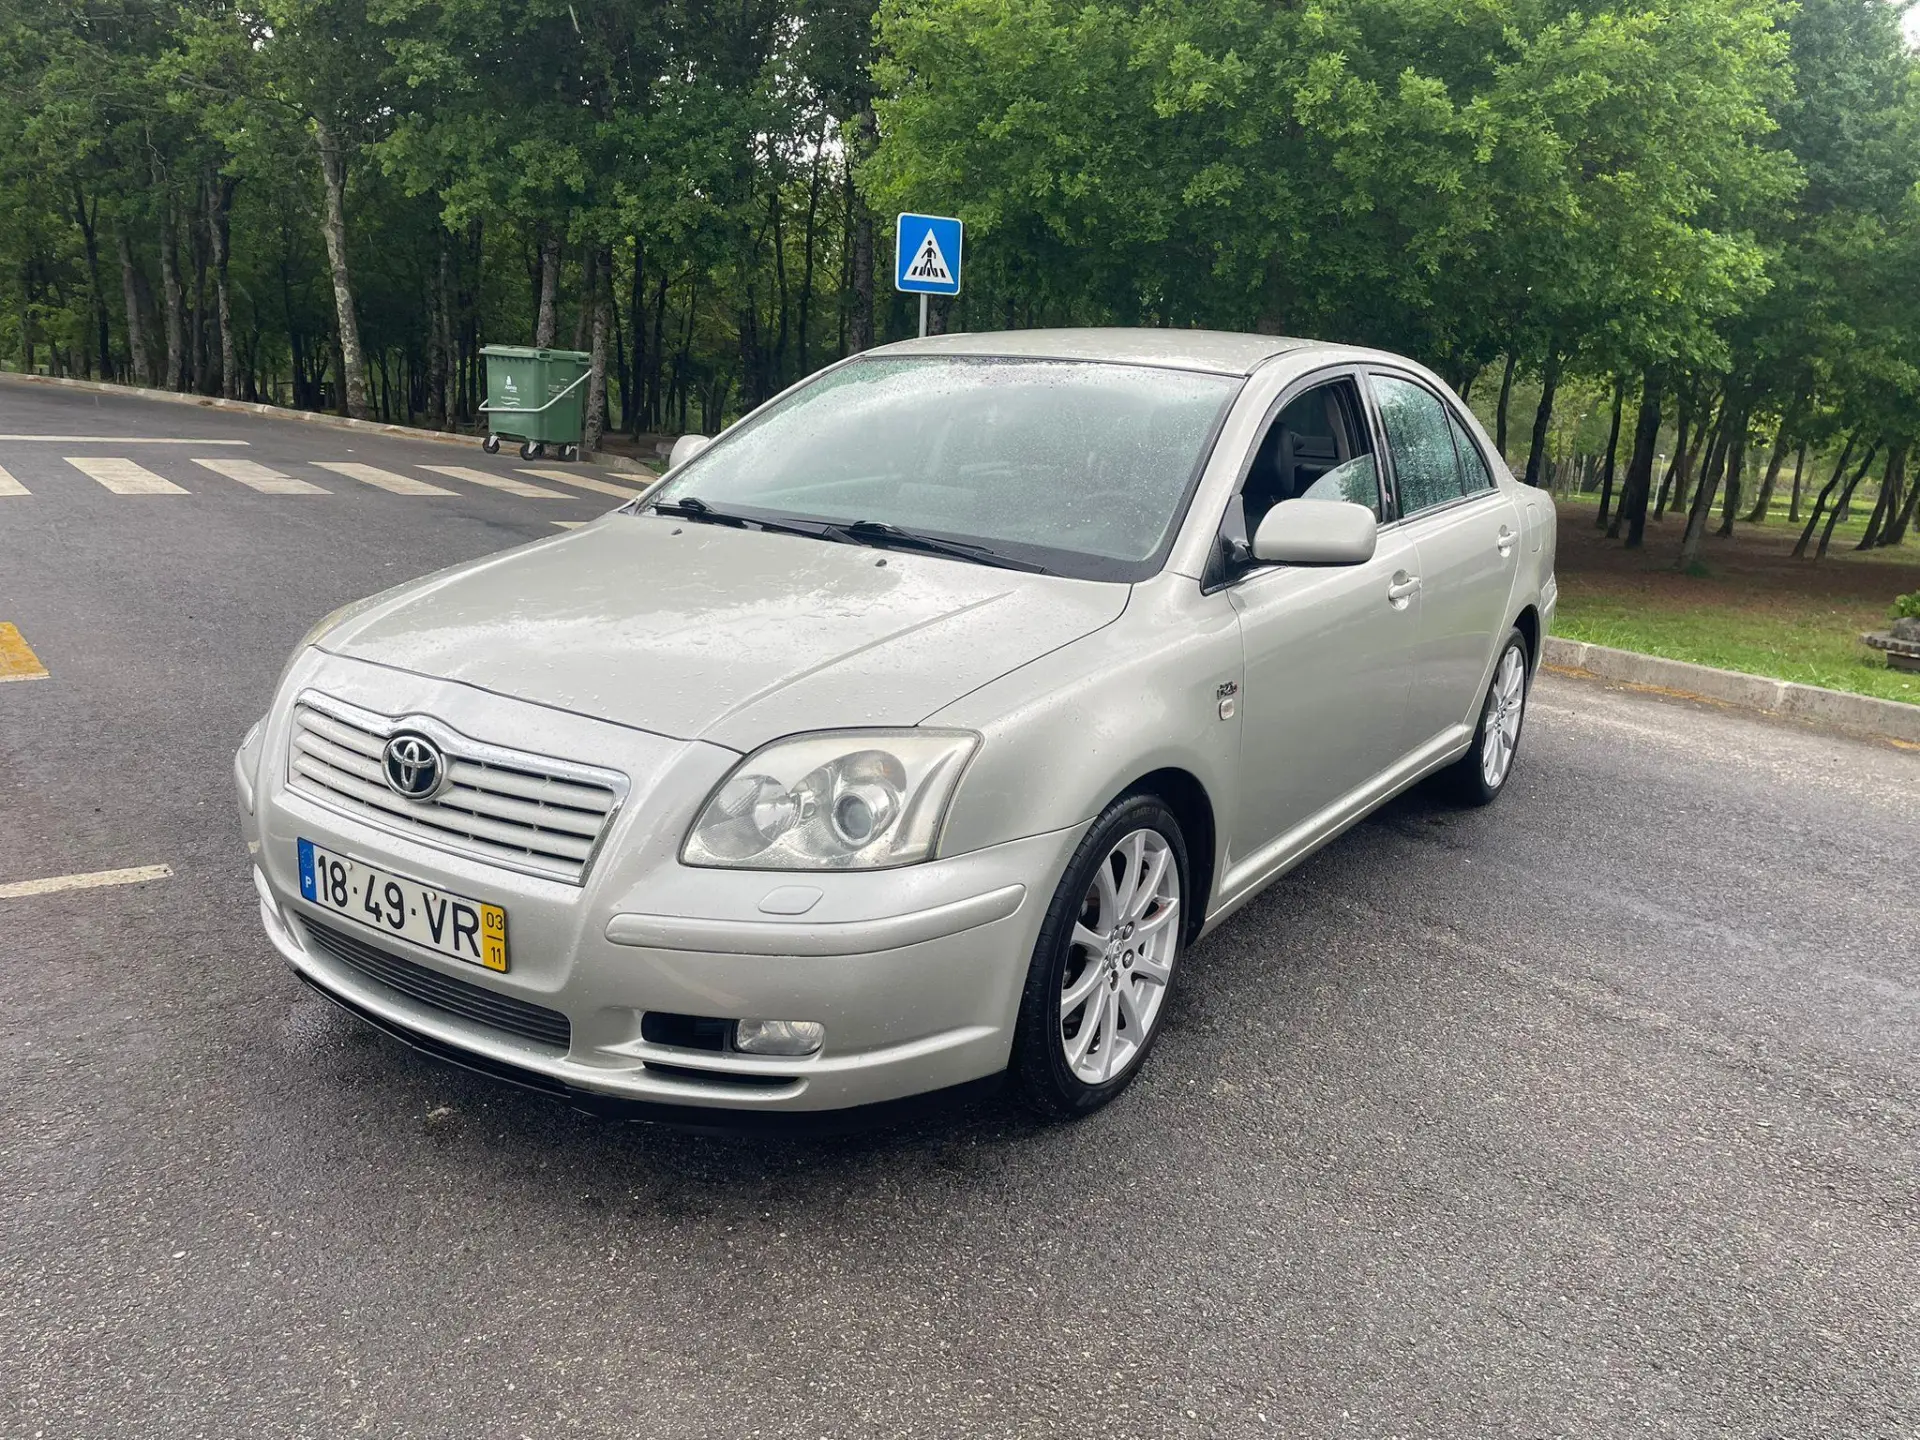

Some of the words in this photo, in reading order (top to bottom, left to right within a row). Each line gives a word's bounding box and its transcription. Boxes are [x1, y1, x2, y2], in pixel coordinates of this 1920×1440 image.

[305, 876, 312, 888] P
[486, 912, 503, 931] 03
[490, 946, 502, 965] 11
